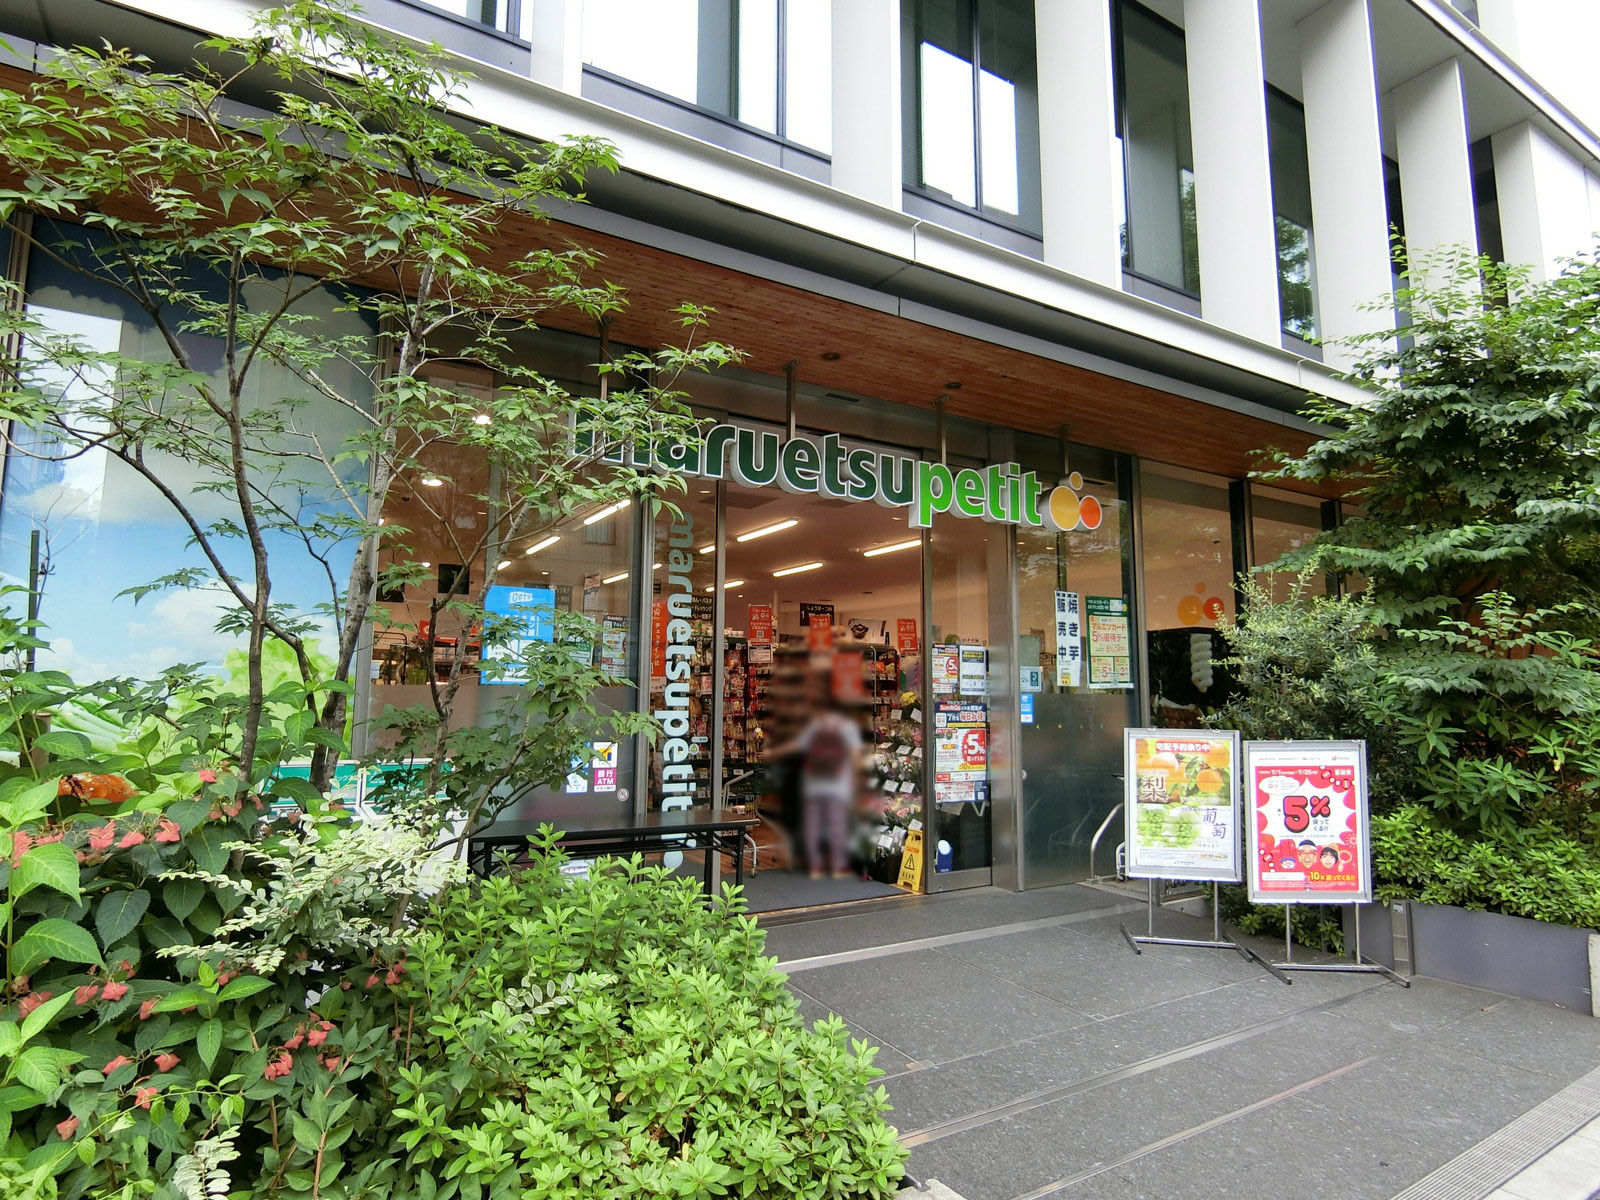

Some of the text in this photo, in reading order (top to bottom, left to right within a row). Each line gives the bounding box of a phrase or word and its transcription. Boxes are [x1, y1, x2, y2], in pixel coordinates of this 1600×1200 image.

[1057, 598, 1066, 660] 販売中
[1068, 599, 1079, 660] 焼き芋
[1092, 623, 1126, 631] マルエツカード
[655, 512, 697, 812] maruetsupetit
[598, 770, 613, 778] 銀行
[1141, 776, 1168, 801] 梨
[1283, 796, 1330, 833] 5%
